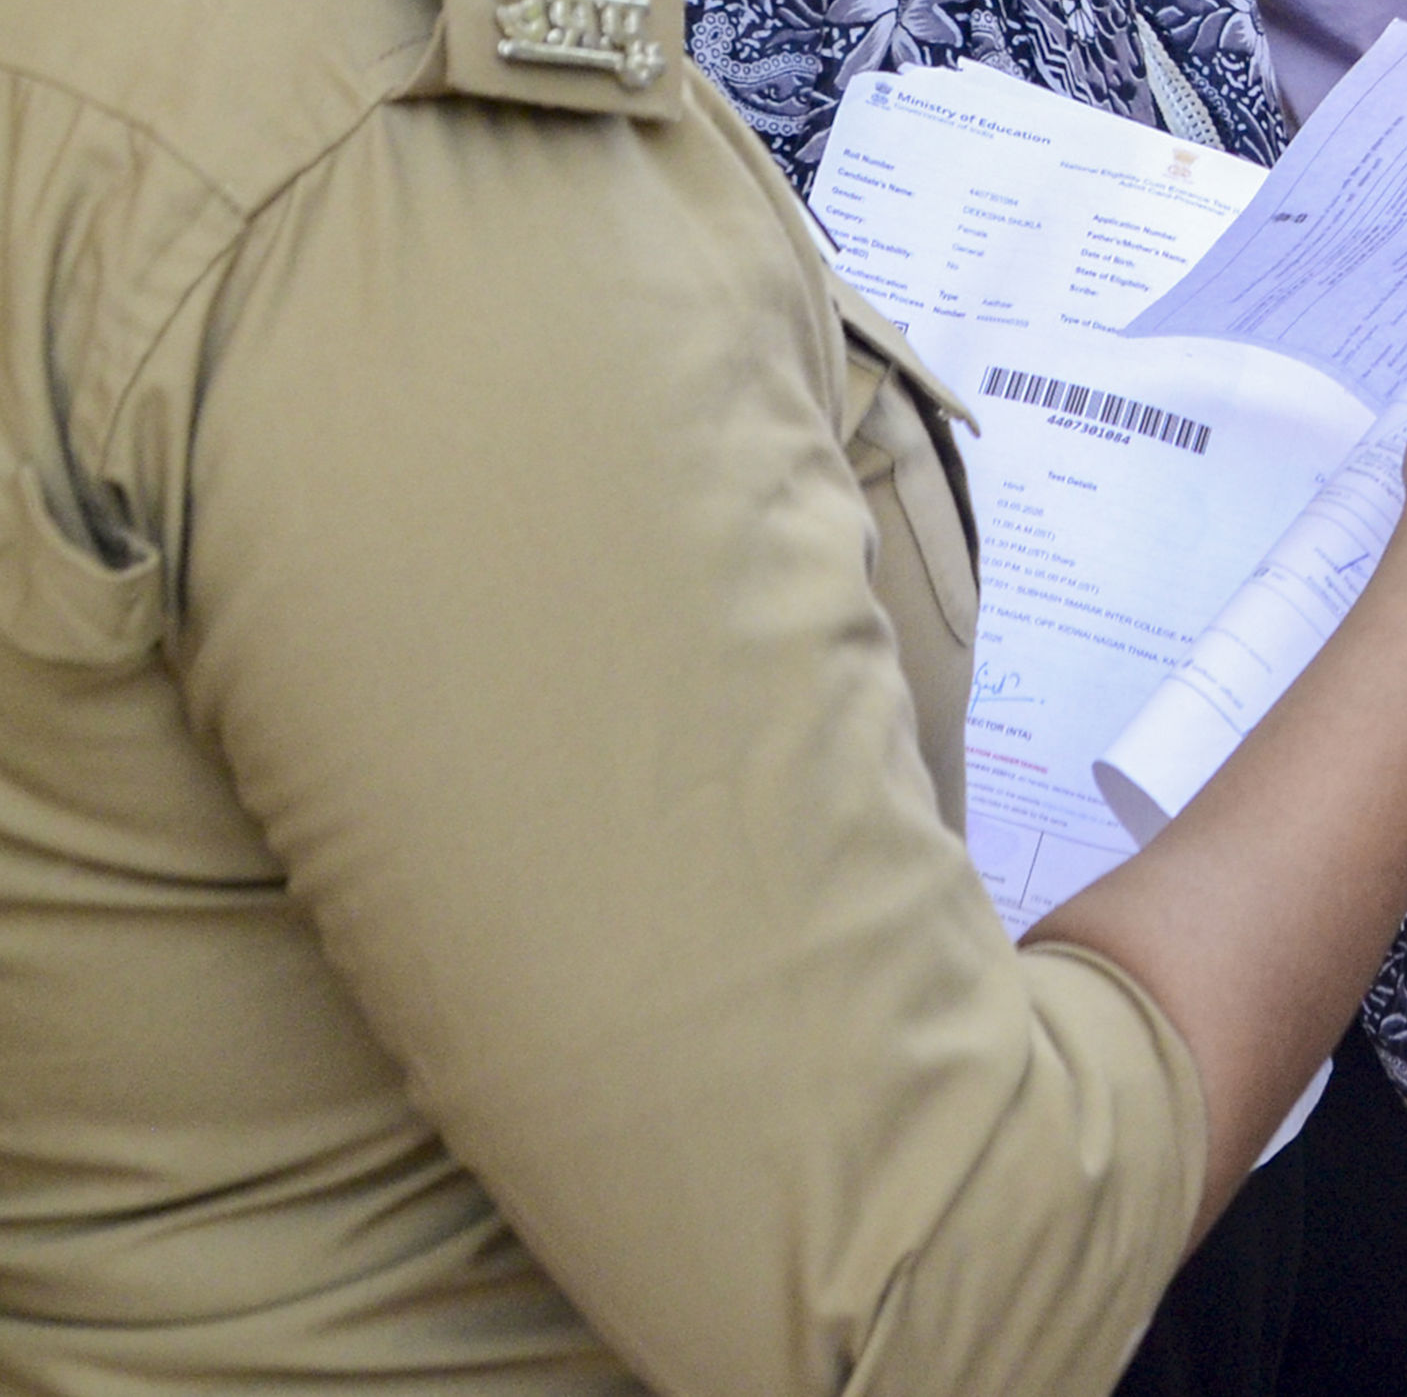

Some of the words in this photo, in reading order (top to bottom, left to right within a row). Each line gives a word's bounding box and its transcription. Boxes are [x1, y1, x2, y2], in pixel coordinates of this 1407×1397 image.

[897, 91, 956, 119] Ministry
[959, 113, 976, 124] of
[979, 117, 1051, 145] Education
[1046, 414, 1131, 446] 4407301084
